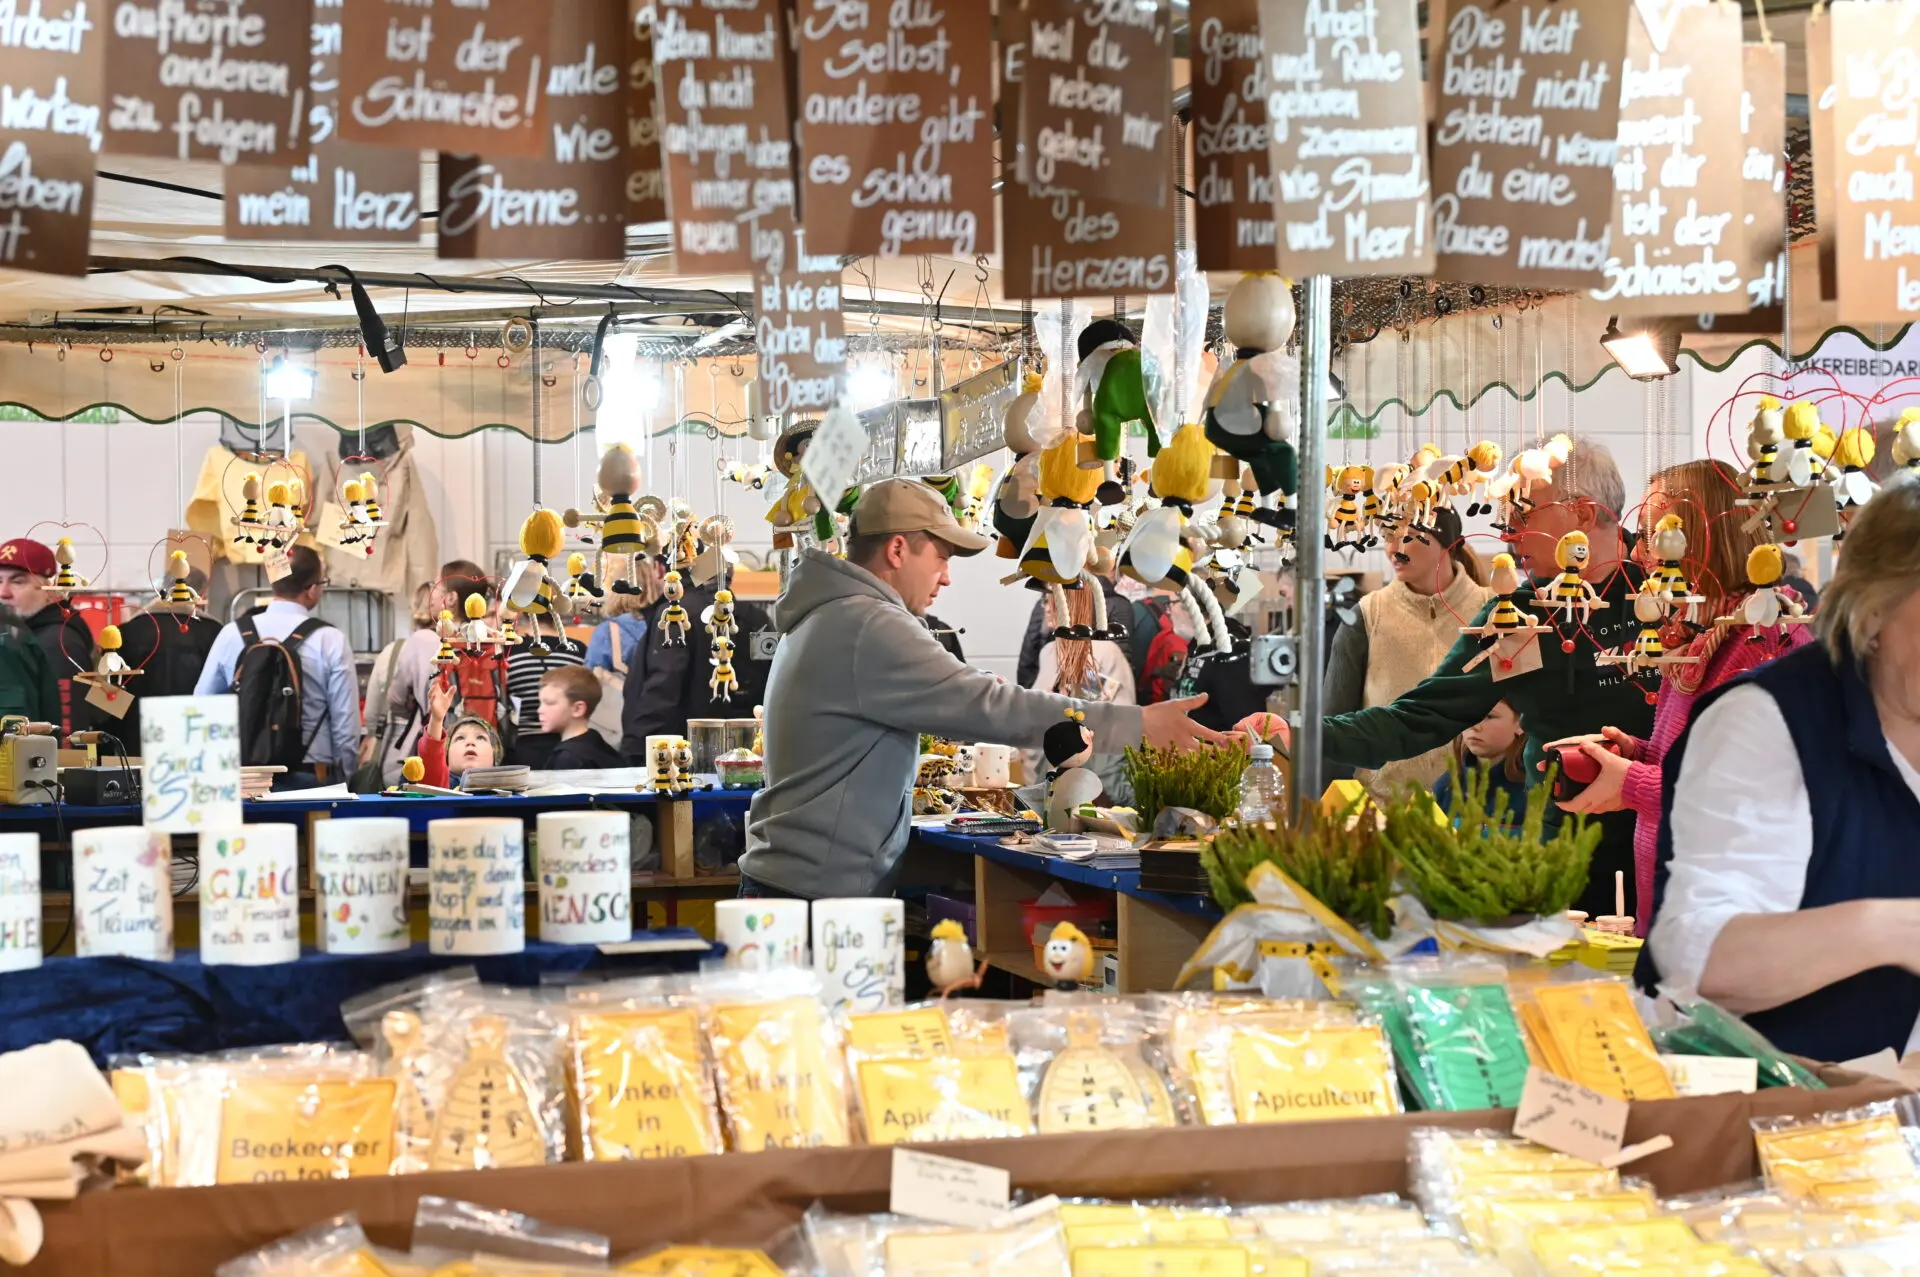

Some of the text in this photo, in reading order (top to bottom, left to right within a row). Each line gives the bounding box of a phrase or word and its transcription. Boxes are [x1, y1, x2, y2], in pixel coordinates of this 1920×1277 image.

[386, 17, 435, 62] ist
[455, 21, 523, 72] der
[1087, 23, 1131, 70] du
[1448, 6, 1582, 55] Die Welt
[159, 44, 289, 97] anderen
[1443, 53, 1611, 110] bleibt nicht
[804, 78, 987, 178] andere gibt
[808, 154, 851, 185] es
[1199, 161, 1234, 206] du
[1455, 151, 1578, 207] du eine
[237, 185, 311, 227] mein
[333, 166, 420, 231] Herz
[1064, 200, 1120, 244] des
[1622, 187, 1733, 247] ist der
[878, 208, 977, 260] genug
[1031, 244, 1170, 297] Herzens
[1254, 1087, 1376, 1114] Apiculteur
